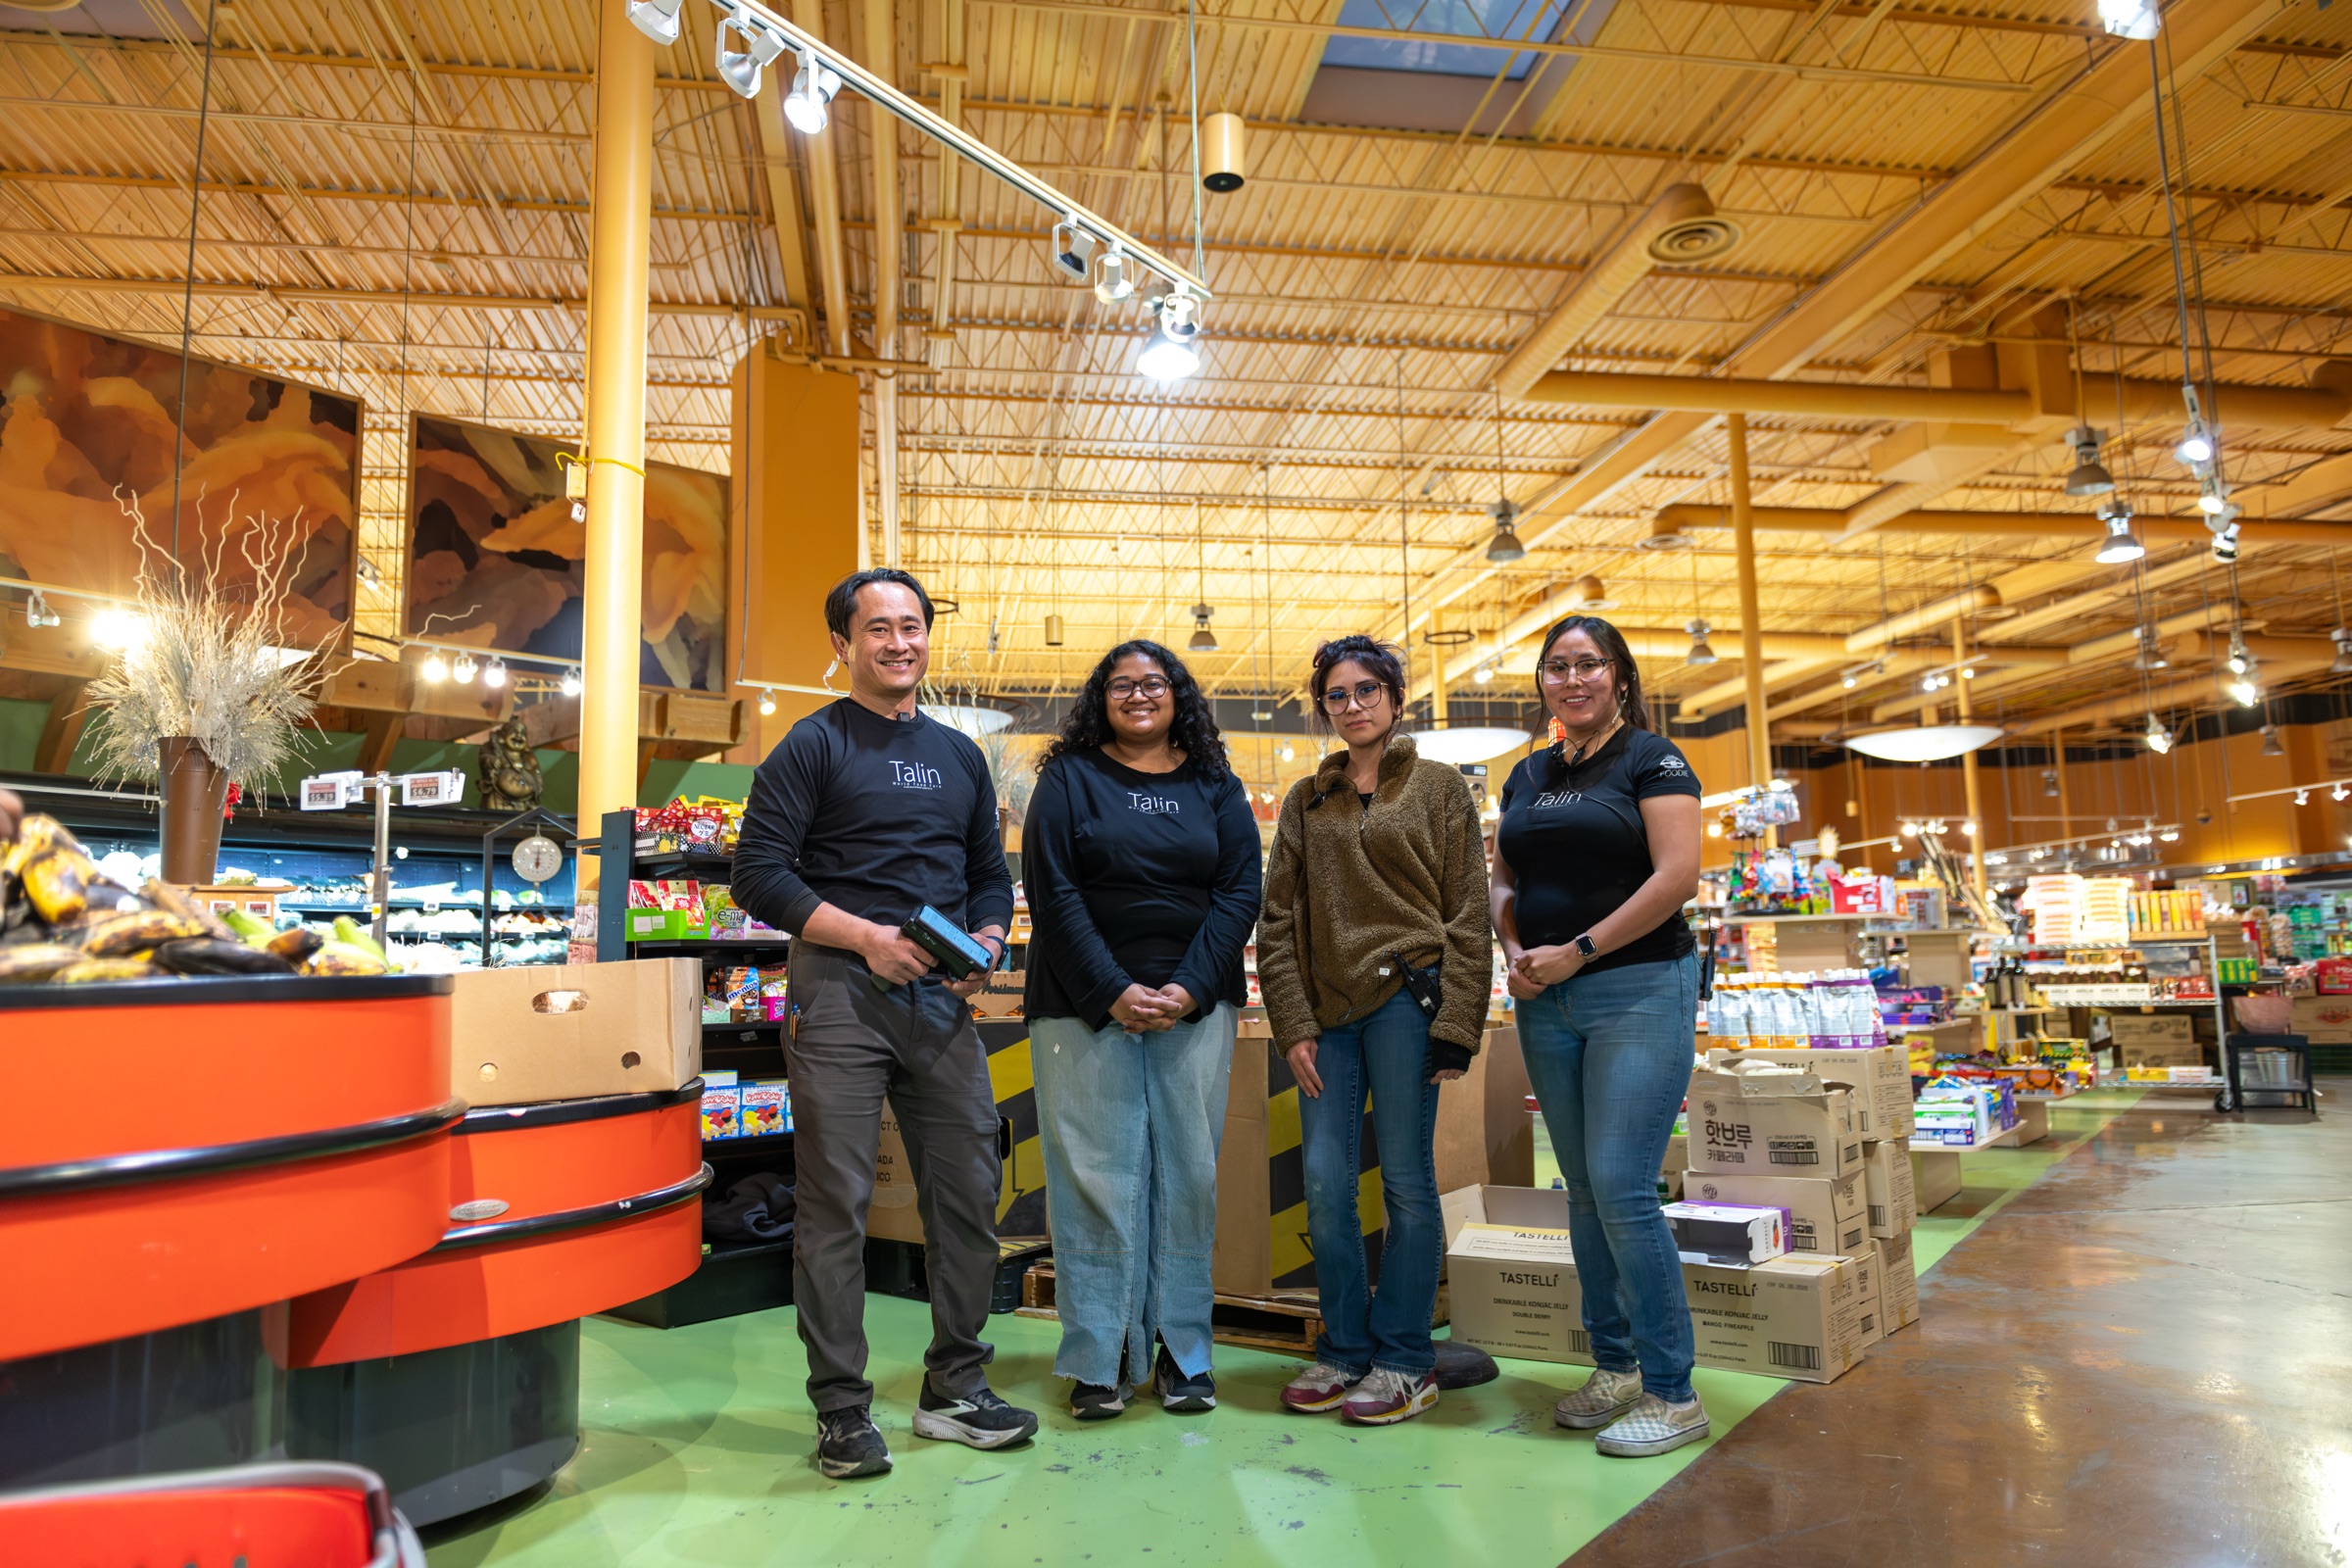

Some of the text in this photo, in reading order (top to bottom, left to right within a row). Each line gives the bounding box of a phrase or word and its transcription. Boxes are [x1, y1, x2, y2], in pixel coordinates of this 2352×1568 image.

[889, 760, 941, 784] Talin
[413, 787, 437, 796] $6.79
[310, 793, 334, 802] $5.39
[1128, 792, 1179, 811] Talin
[1535, 791, 1582, 807] Talin
[727, 981, 759, 1000] mentos
[1705, 1119, 1752, 1150] 핫브루
[877, 1154, 894, 1165] ADA
[876, 1172, 891, 1182] ICO
[1494, 1298, 1527, 1306] DRINKABLE
[1528, 1300, 1552, 1309] KONJAC
[1724, 1310, 1751, 1320] KONJAC
